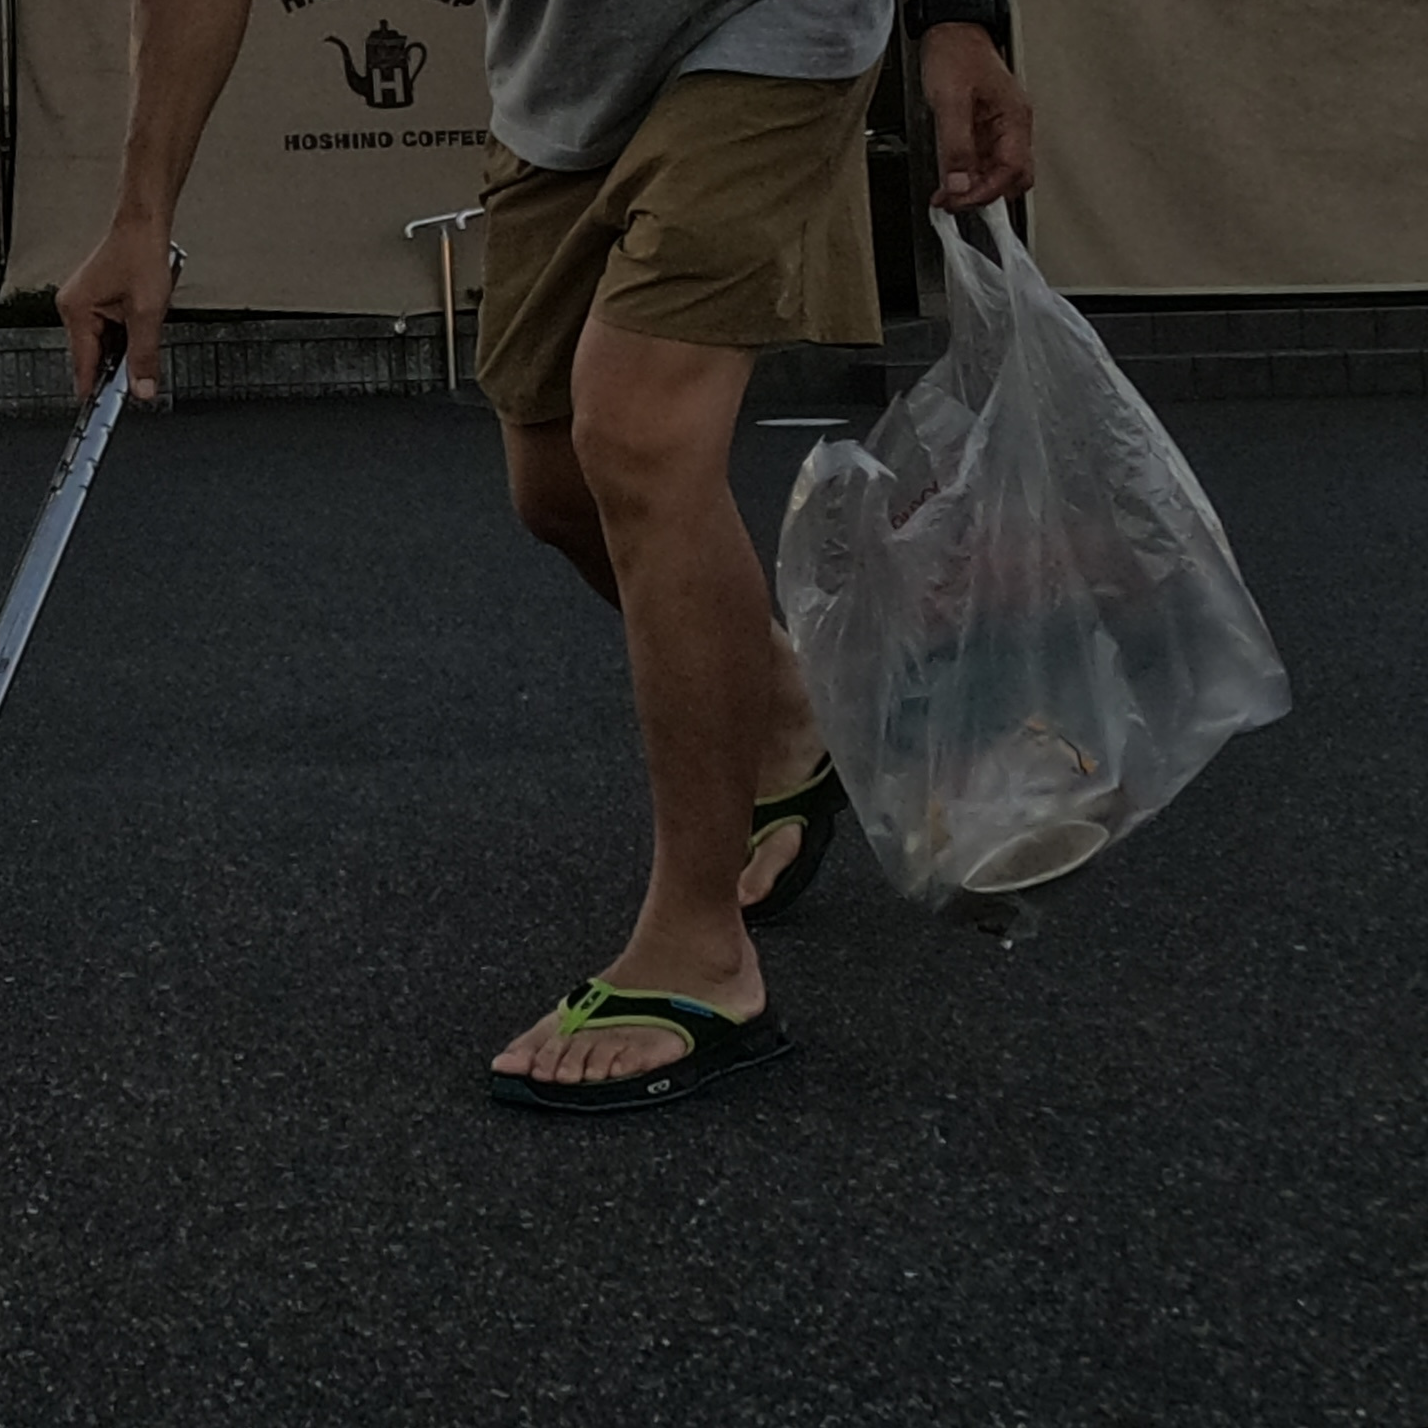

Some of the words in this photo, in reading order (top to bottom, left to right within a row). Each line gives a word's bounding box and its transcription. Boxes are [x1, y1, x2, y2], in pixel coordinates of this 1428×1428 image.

[372, 67, 405, 103] H
[284, 131, 393, 151] HOSHINO
[402, 129, 488, 148] COFFEE
